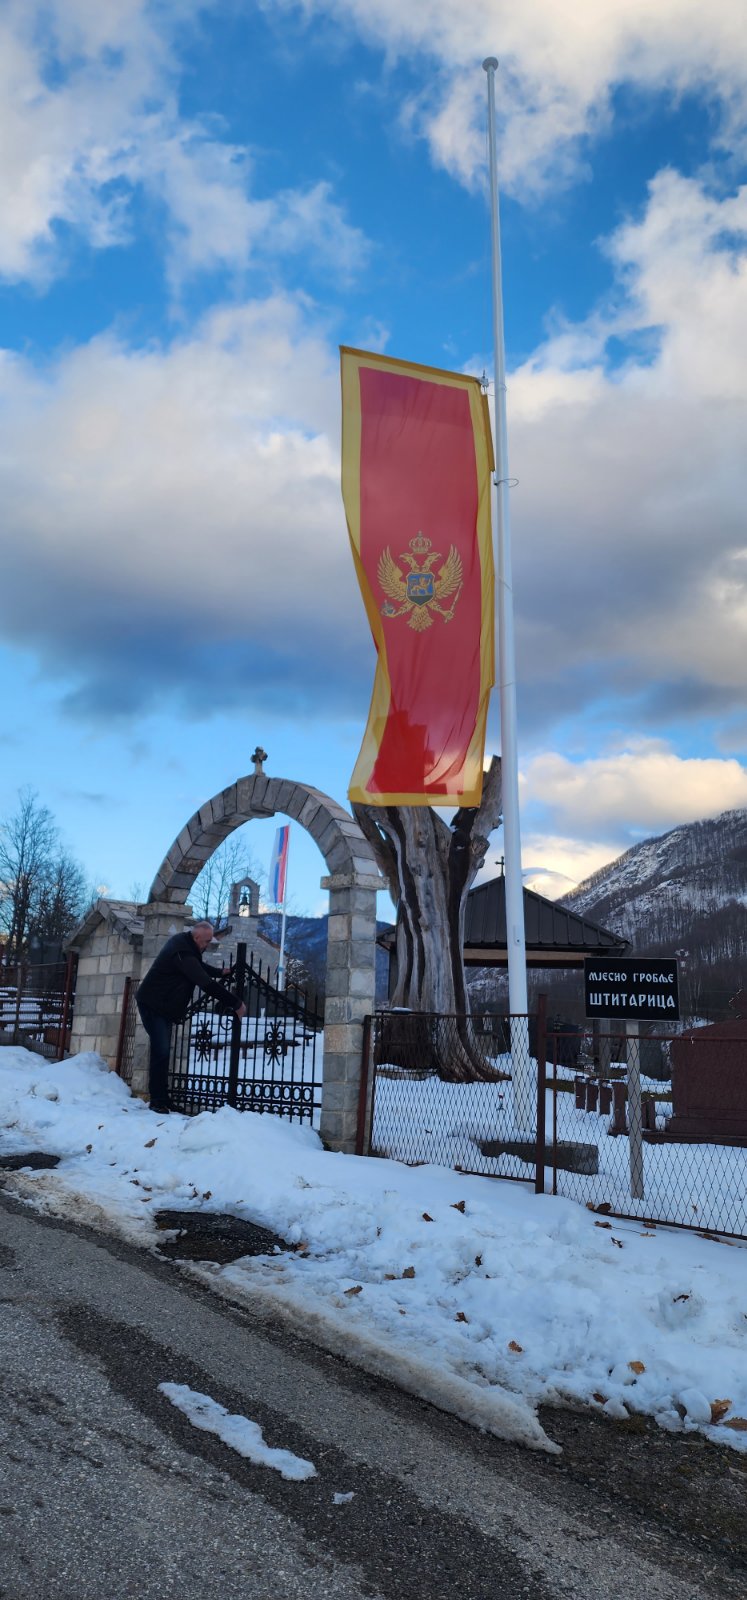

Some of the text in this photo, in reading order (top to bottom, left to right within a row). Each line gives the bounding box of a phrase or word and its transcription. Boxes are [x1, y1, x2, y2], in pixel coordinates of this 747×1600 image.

[588, 972, 674, 983] МЈЕСНО ГРОБЉЕ
[589, 992, 676, 1009] ШТИТАРИЦА
